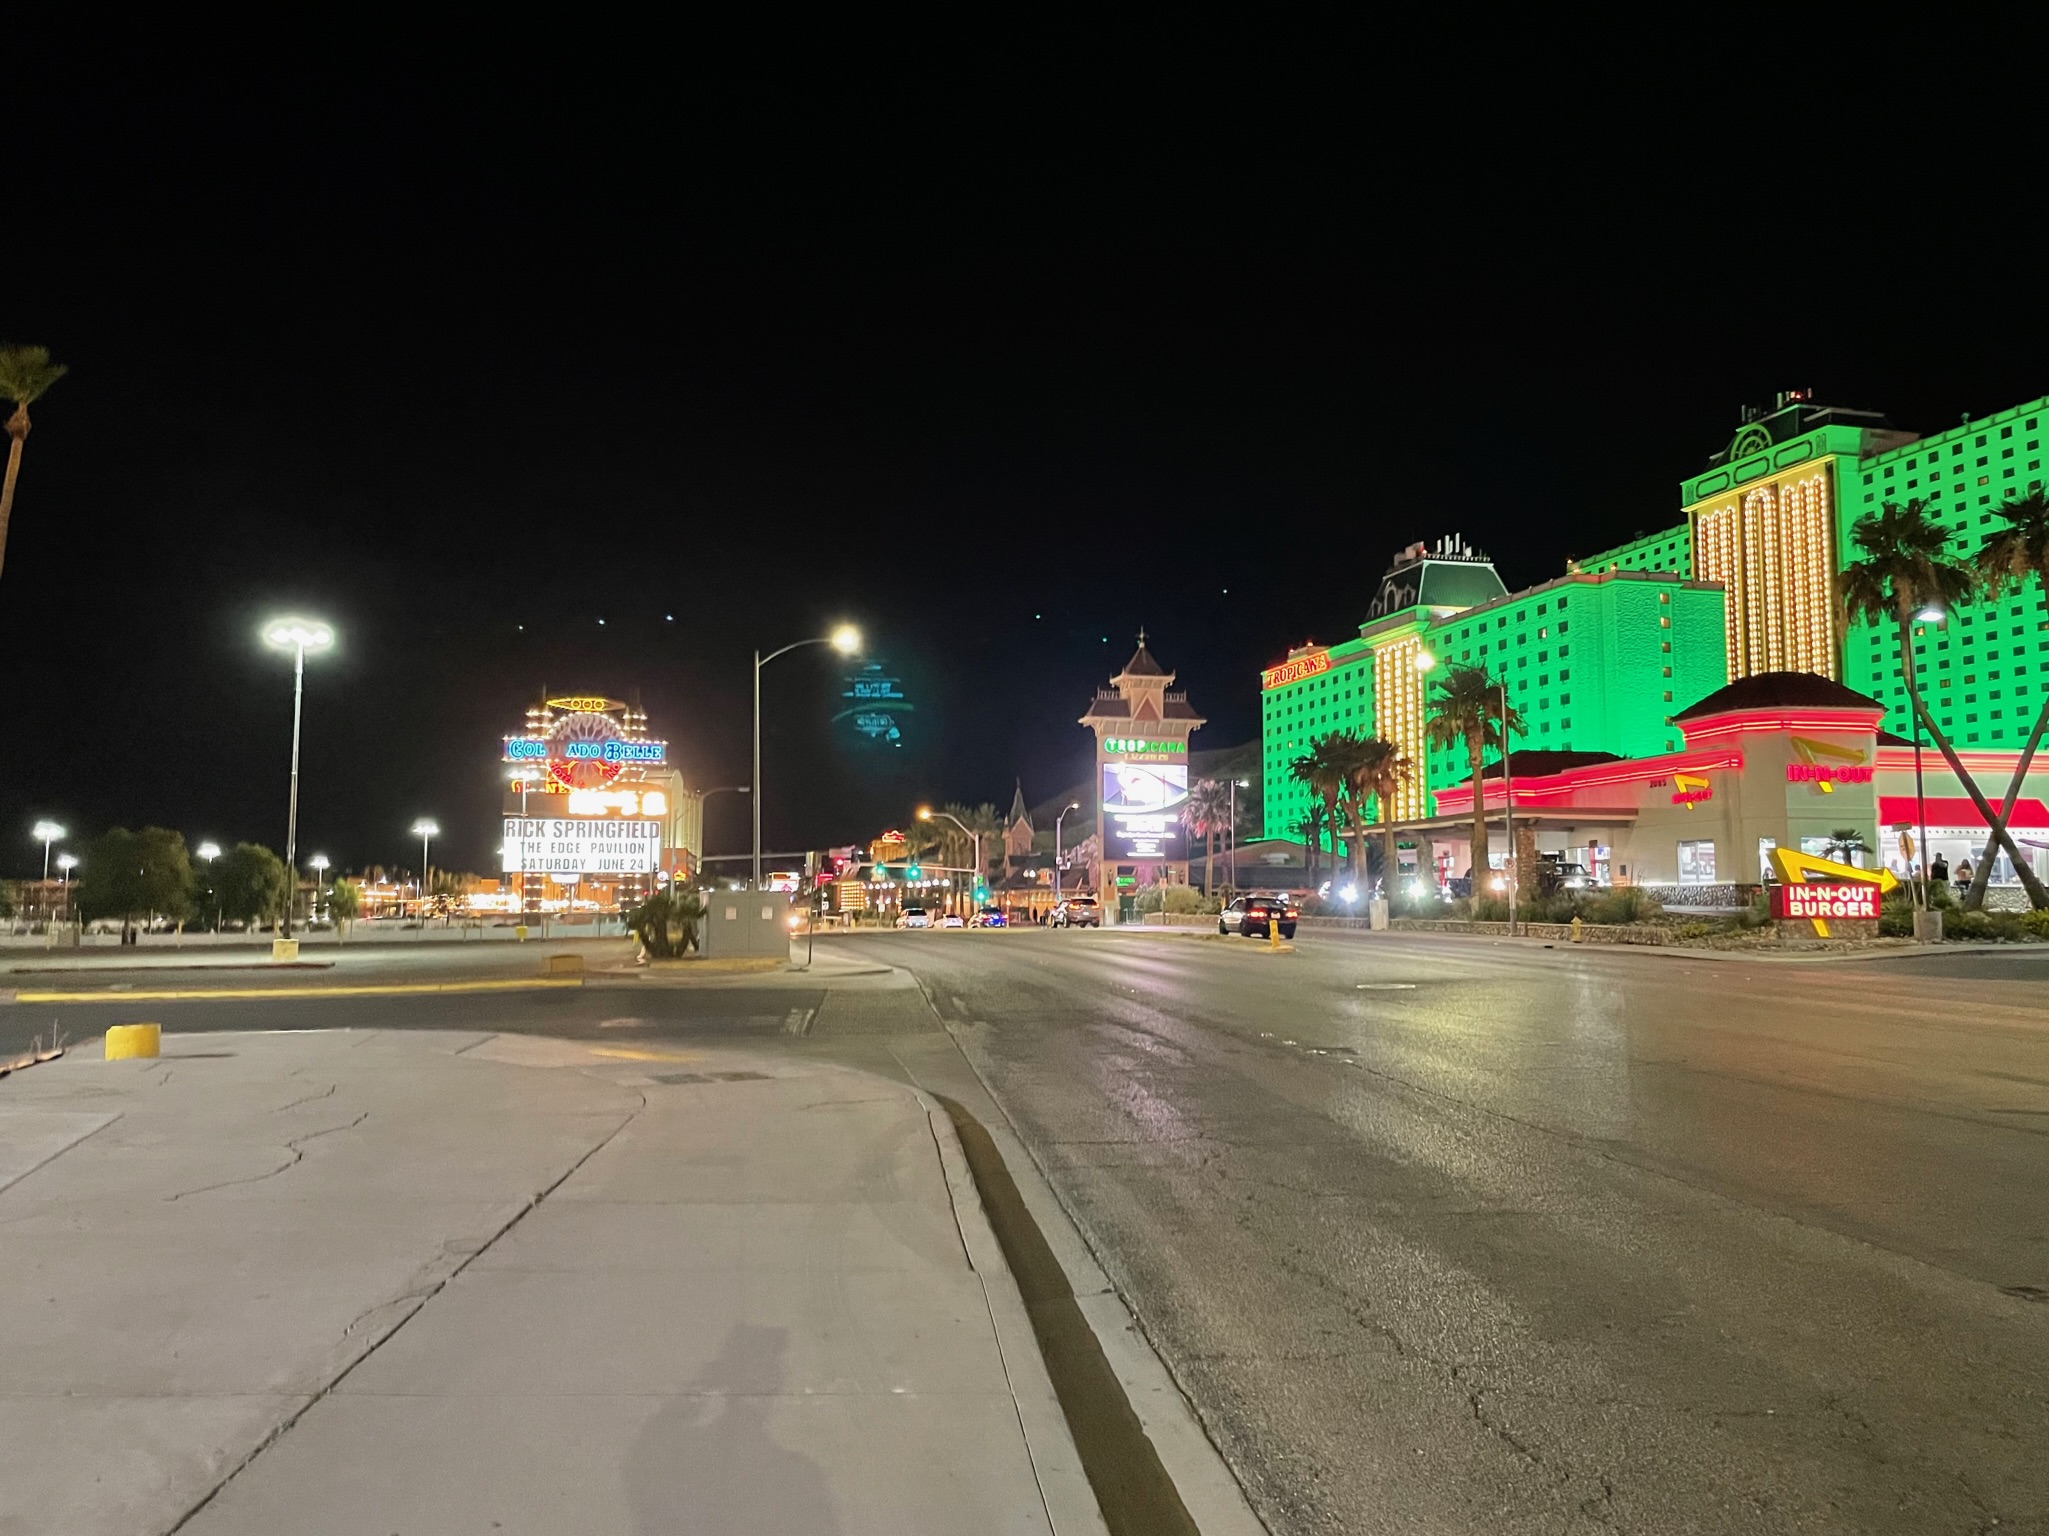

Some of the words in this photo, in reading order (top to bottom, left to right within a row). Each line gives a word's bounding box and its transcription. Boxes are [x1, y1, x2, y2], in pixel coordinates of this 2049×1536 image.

[604, 741, 662, 761] BELLE
[550, 762, 574, 785] HOTEL
[1787, 764, 1875, 783] IN-N-OUT
[505, 820, 546, 838] RICK
[553, 821, 660, 839] SPRINGFIELD
[520, 842, 541, 853] THE
[551, 842, 580, 854] EDGE
[591, 842, 645, 854] PAVILION
[521, 858, 586, 870] SATURDAY
[598, 858, 625, 870] JUNE
[630, 858, 644, 870] 24
[1789, 886, 1875, 901] IN-N-OUT
[1789, 902, 1875, 916] BURGER
